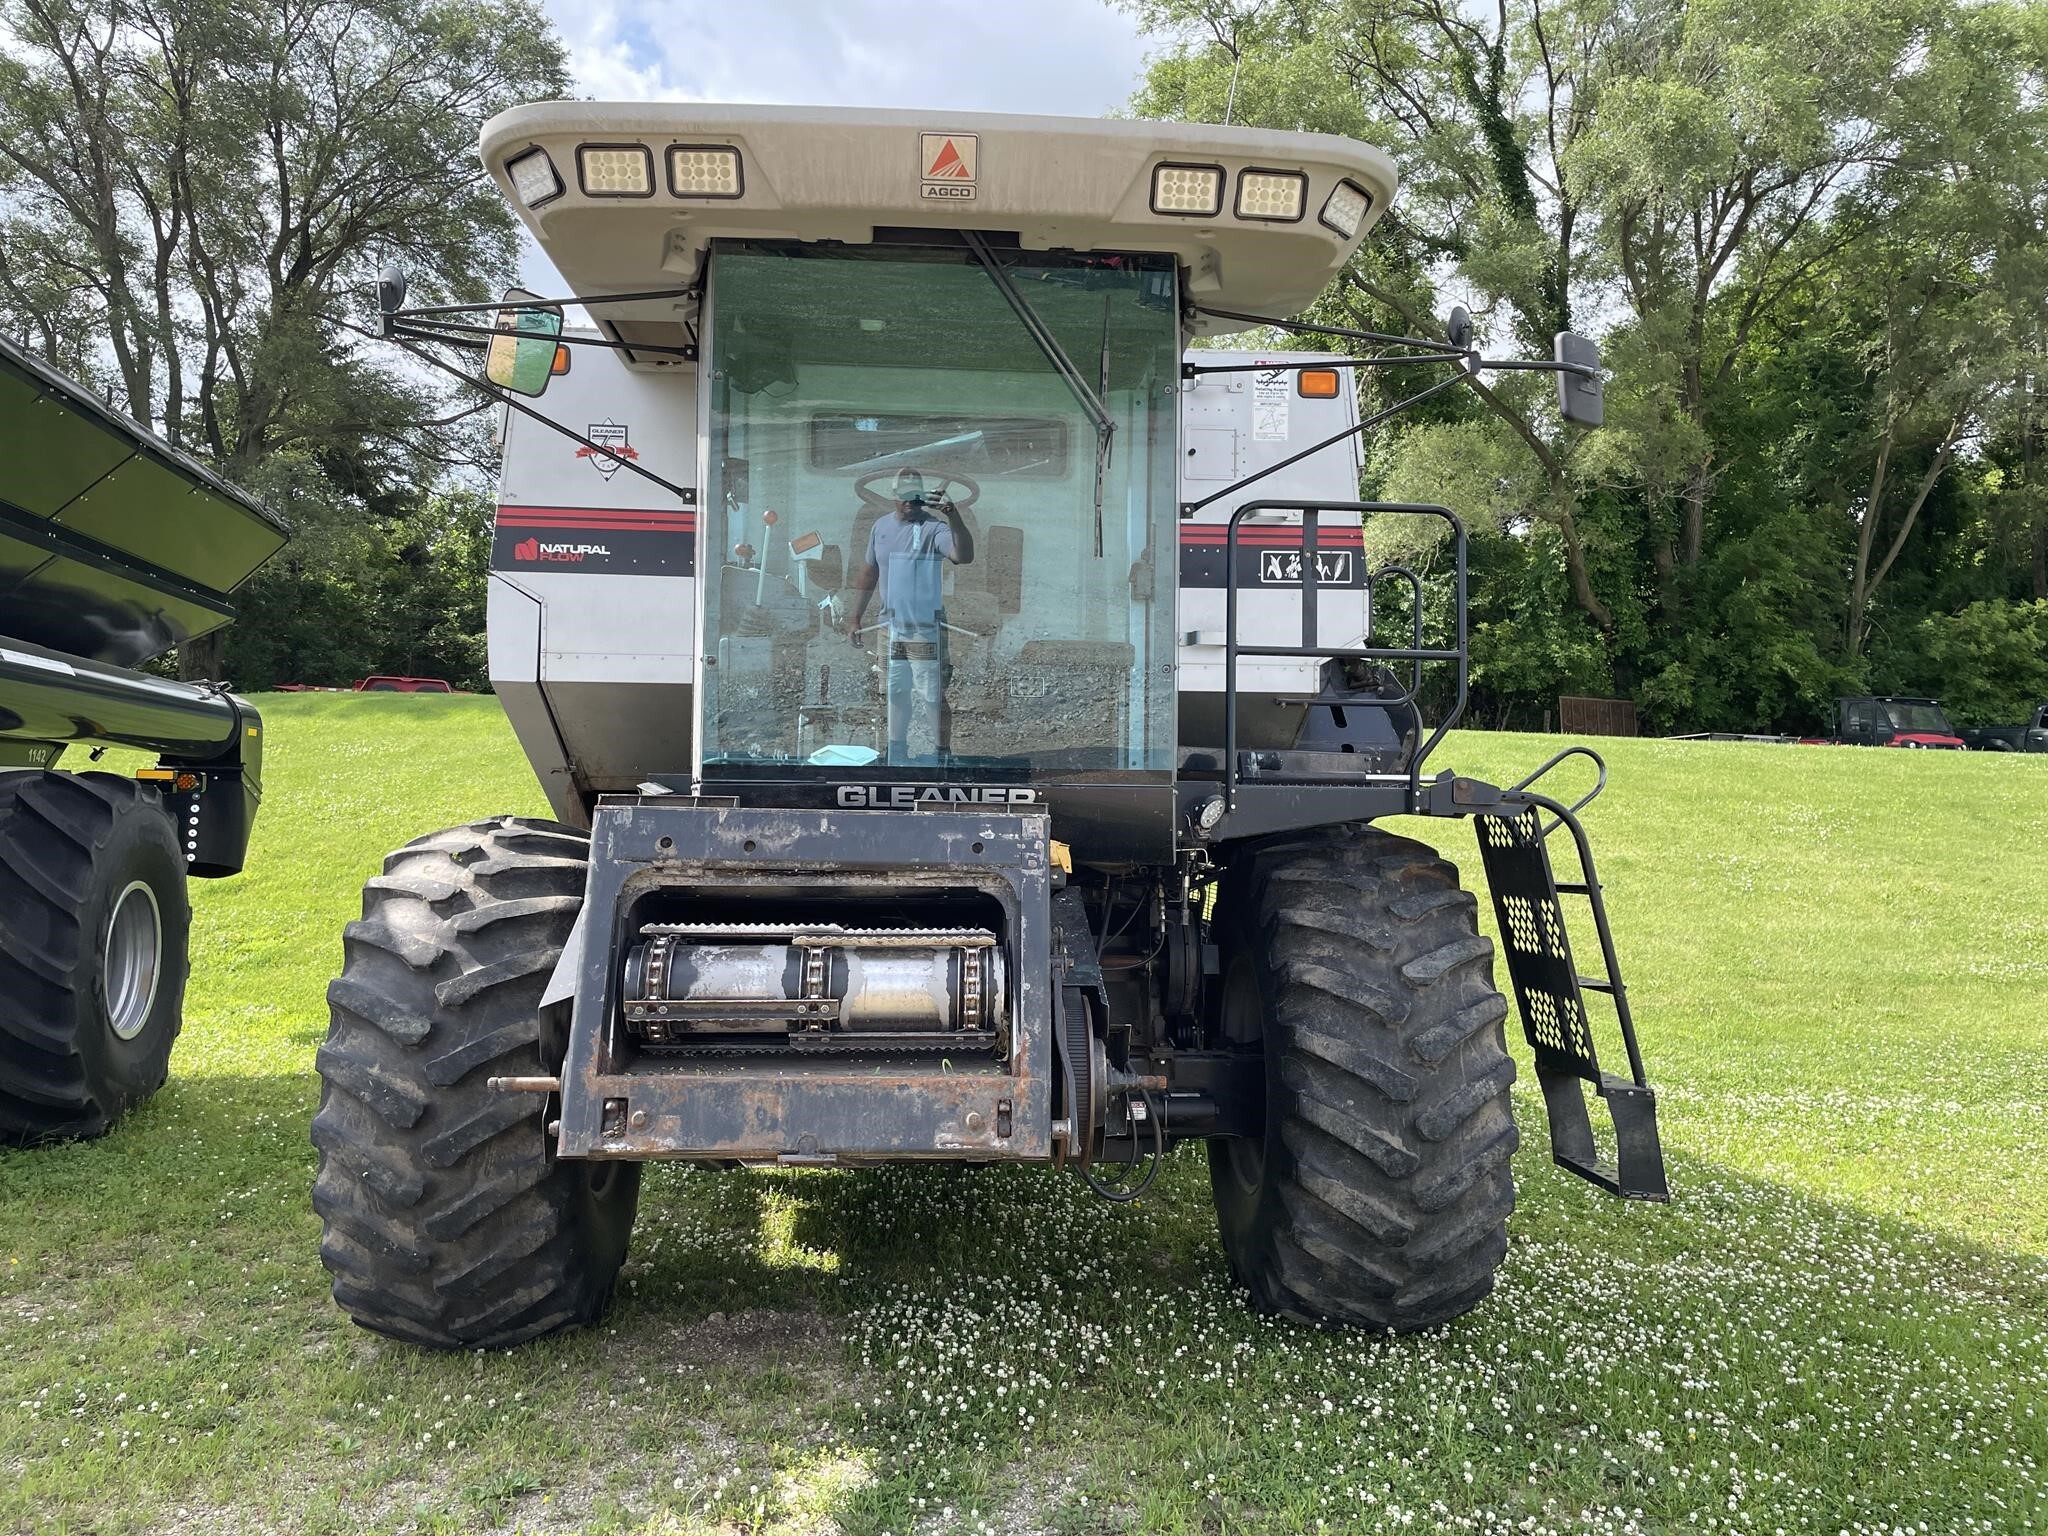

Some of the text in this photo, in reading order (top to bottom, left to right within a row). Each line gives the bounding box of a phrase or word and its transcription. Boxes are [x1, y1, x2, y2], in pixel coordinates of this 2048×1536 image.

[927, 187, 971, 197] AGCO
[540, 543, 611, 555] NATURAL
[540, 553, 585, 562] FLOW
[28, 748, 47, 763] 1142
[836, 785, 1036, 808] GLEANER
